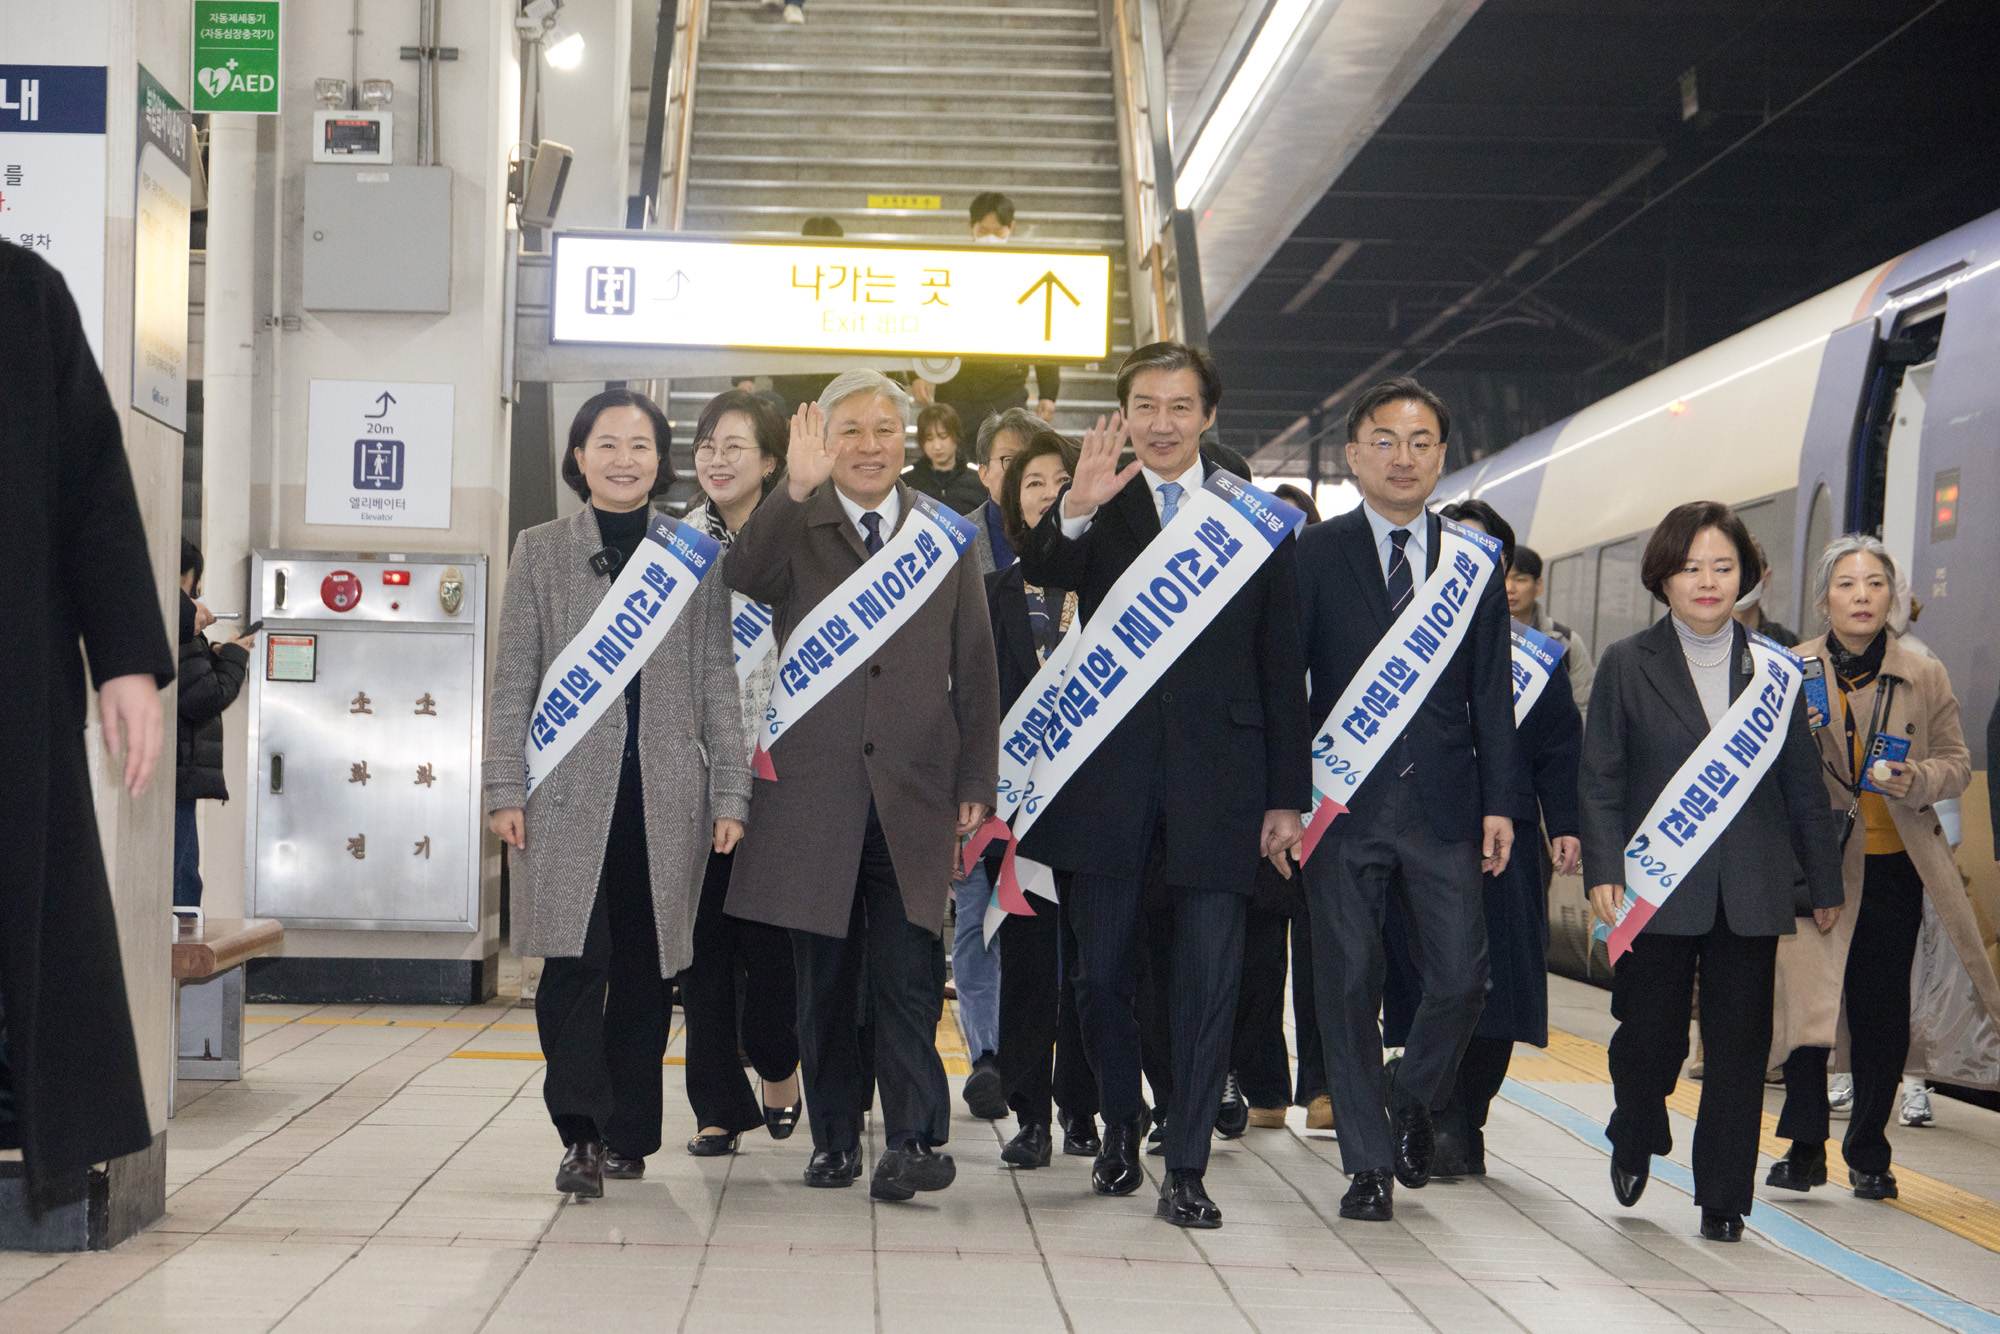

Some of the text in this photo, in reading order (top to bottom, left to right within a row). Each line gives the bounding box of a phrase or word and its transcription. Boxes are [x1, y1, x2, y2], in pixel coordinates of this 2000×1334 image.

[200, 27, 275, 41] (자동심장충격기)
[209, 13, 266, 24] 자동제세동기
[230, 74, 275, 93] AED
[4, 164, 24, 186] 를
[20, 233, 52, 250] 열차
[791, 264, 952, 306] 나가는 곳
[822, 310, 919, 334] Exit 出口
[366, 423, 394, 434] 20m
[349, 497, 406, 510] 엘리베이터
[361, 512, 393, 521] Elevator
[920, 500, 967, 546] 조국혁신당
[1216, 477, 1284, 533] 조국혁신당
[655, 524, 707, 568] 조국혁신당
[1447, 520, 1498, 553] 조국혁신당
[779, 528, 943, 697] 혁신으로 희망찬
[530, 561, 678, 752] 혁신으로 희망찬
[1041, 515, 1244, 762] 혁신으로 희망찬
[1341, 550, 1480, 745] 혁신으로 희망찬
[1312, 732, 1363, 786] 2026
[1657, 658, 1790, 848] 혁신으로 희망찬
[1626, 832, 1679, 888] 2026
